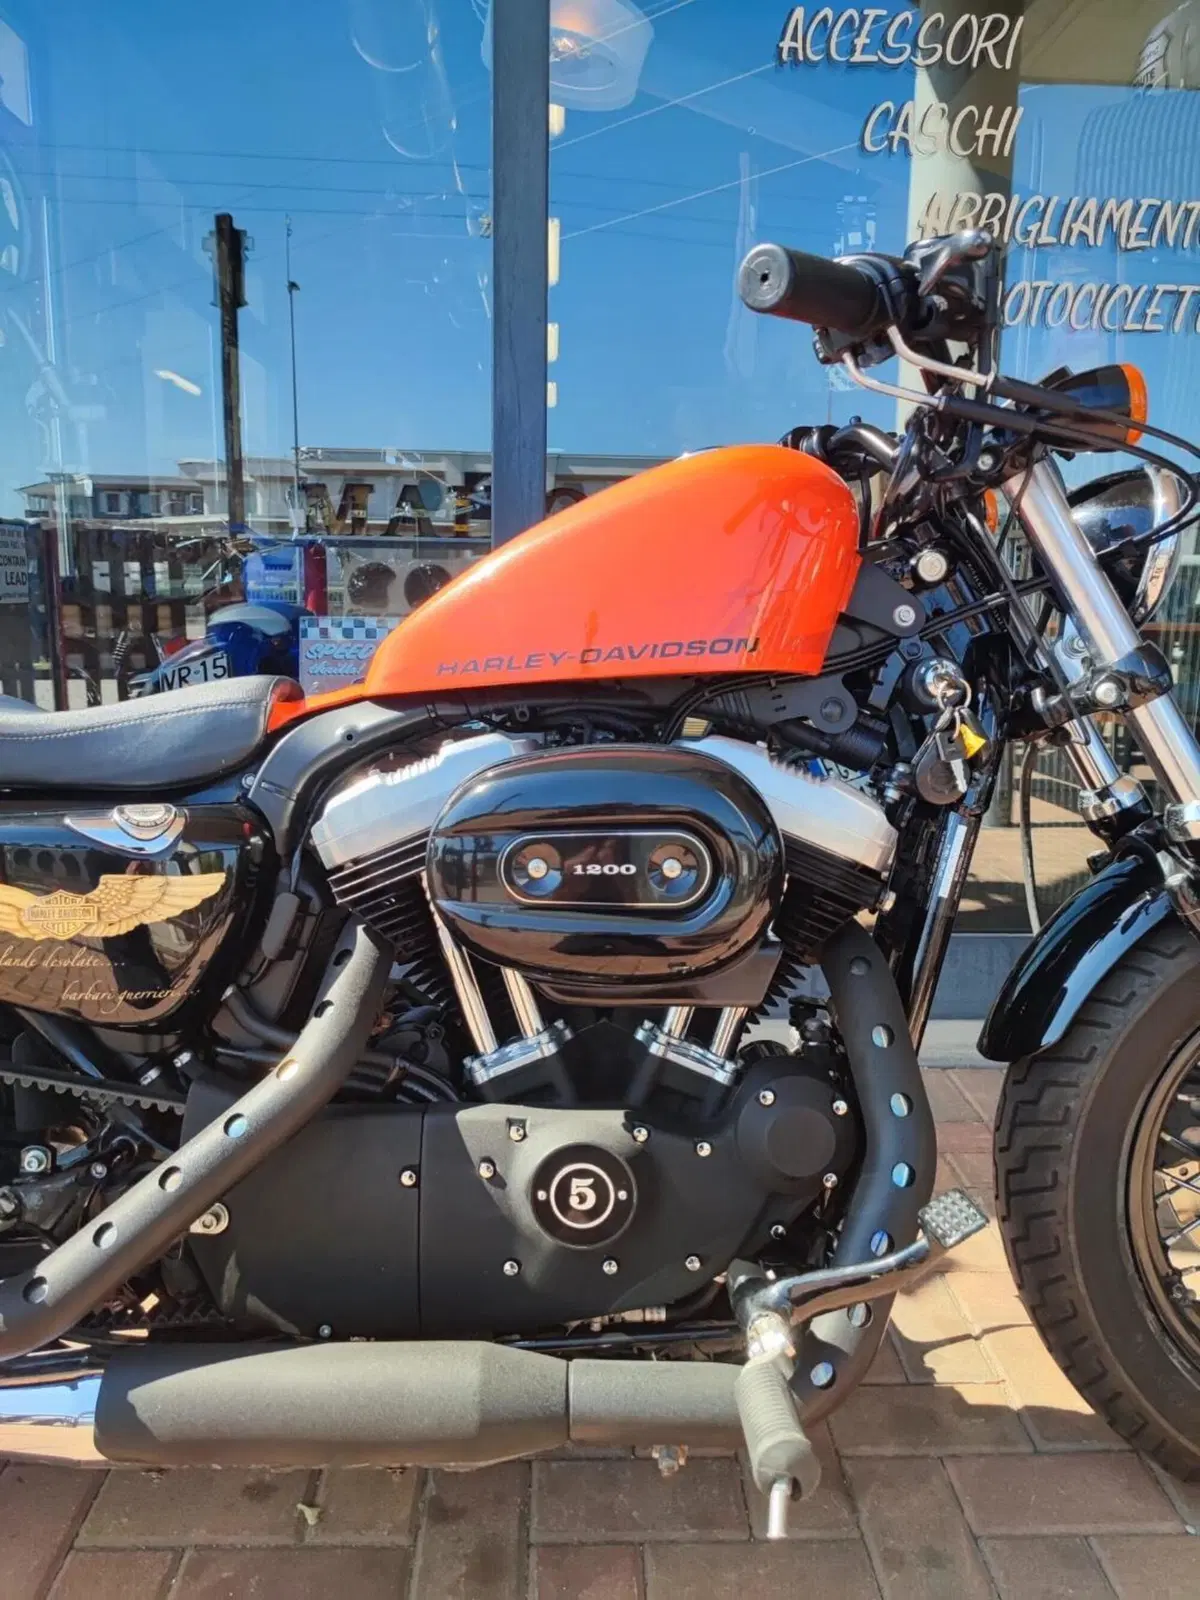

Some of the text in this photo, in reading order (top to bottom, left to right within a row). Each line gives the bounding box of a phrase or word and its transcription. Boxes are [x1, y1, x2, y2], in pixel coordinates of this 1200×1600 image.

[778, 6, 1025, 70] ACCESSORI
[862, 100, 1025, 159] CASCHI
[917, 191, 1200, 249] ABBIGLIAMENT
[997, 279, 1200, 333] OTOCICLETT
[5, 570, 28, 586] LEAD
[436, 637, 760, 676] HARLEY-DAVIDSON
[572, 863, 638, 876] 1200
[568, 1177, 597, 1211] 5
